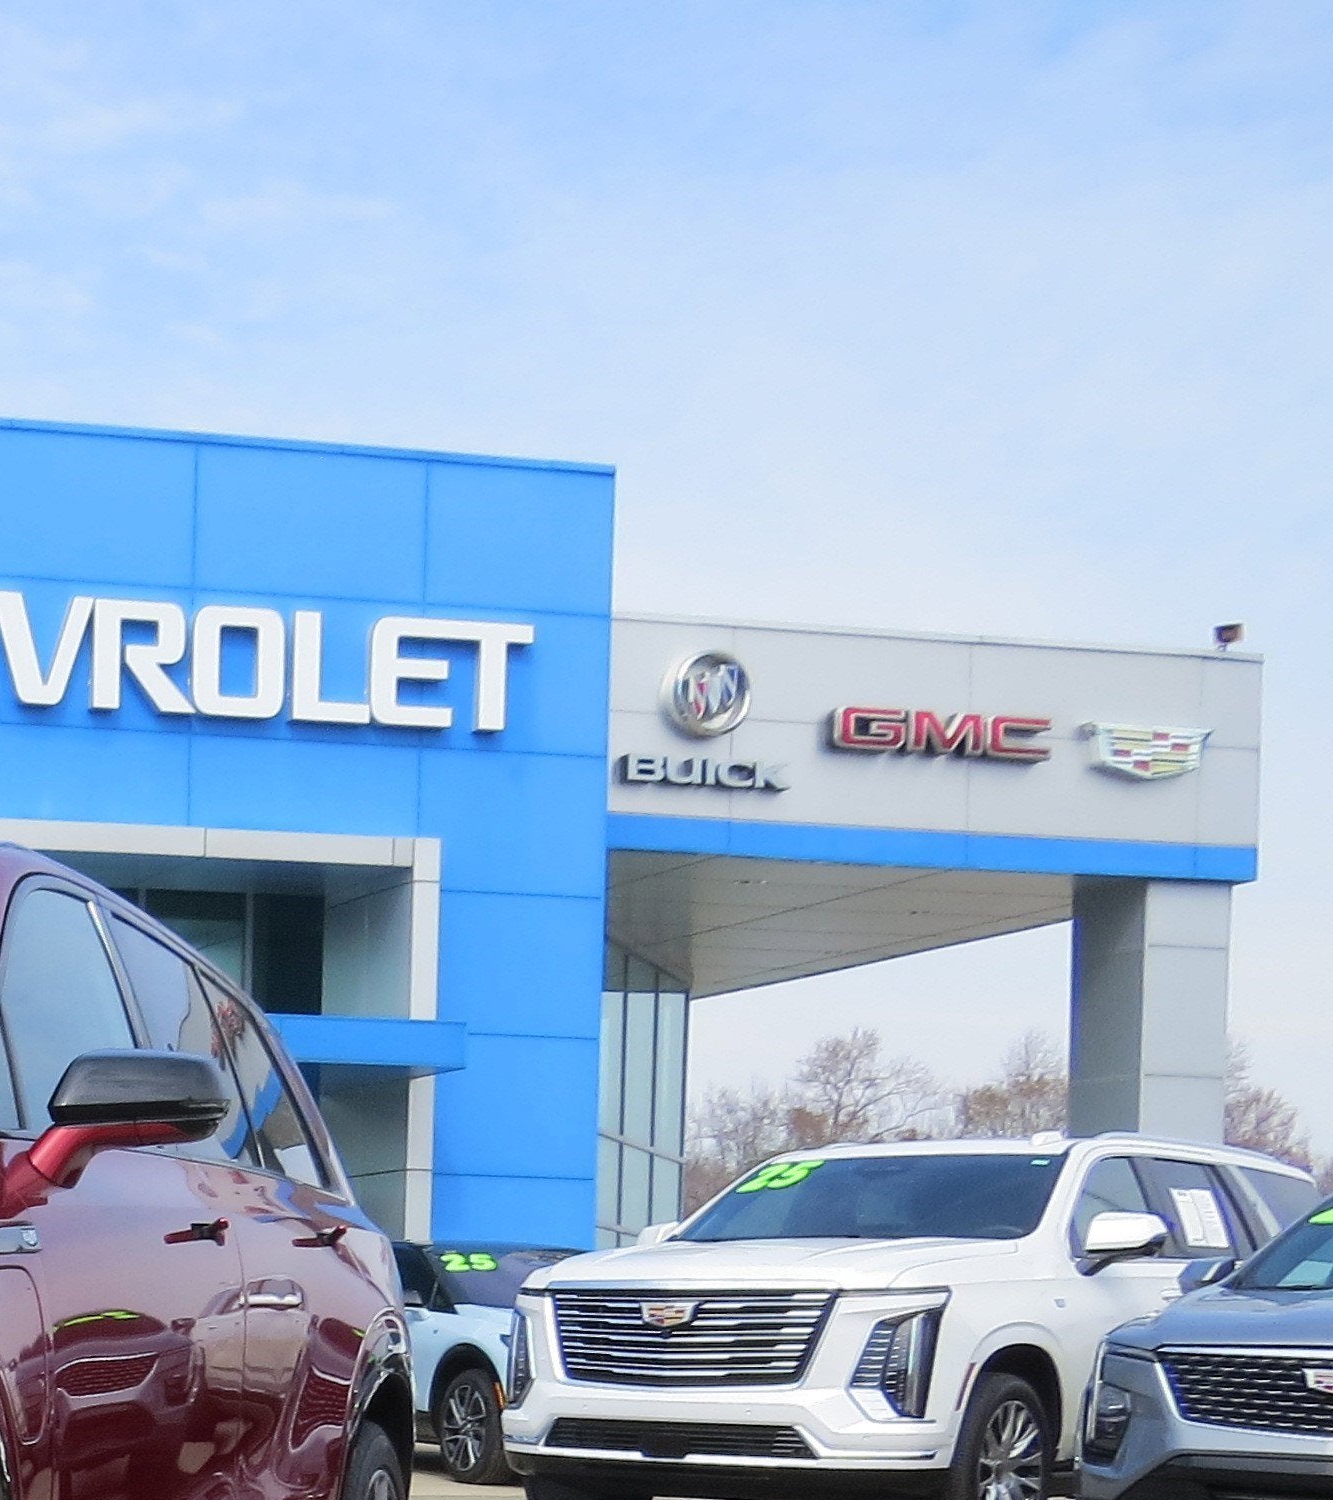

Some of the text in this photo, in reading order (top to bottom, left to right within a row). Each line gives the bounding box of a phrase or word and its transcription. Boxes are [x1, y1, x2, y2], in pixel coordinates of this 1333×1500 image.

[832, 704, 1053, 762] GMC
[620, 752, 791, 793] BUICK
[734, 1160, 826, 1194] 25
[439, 1252, 497, 1273] 25
